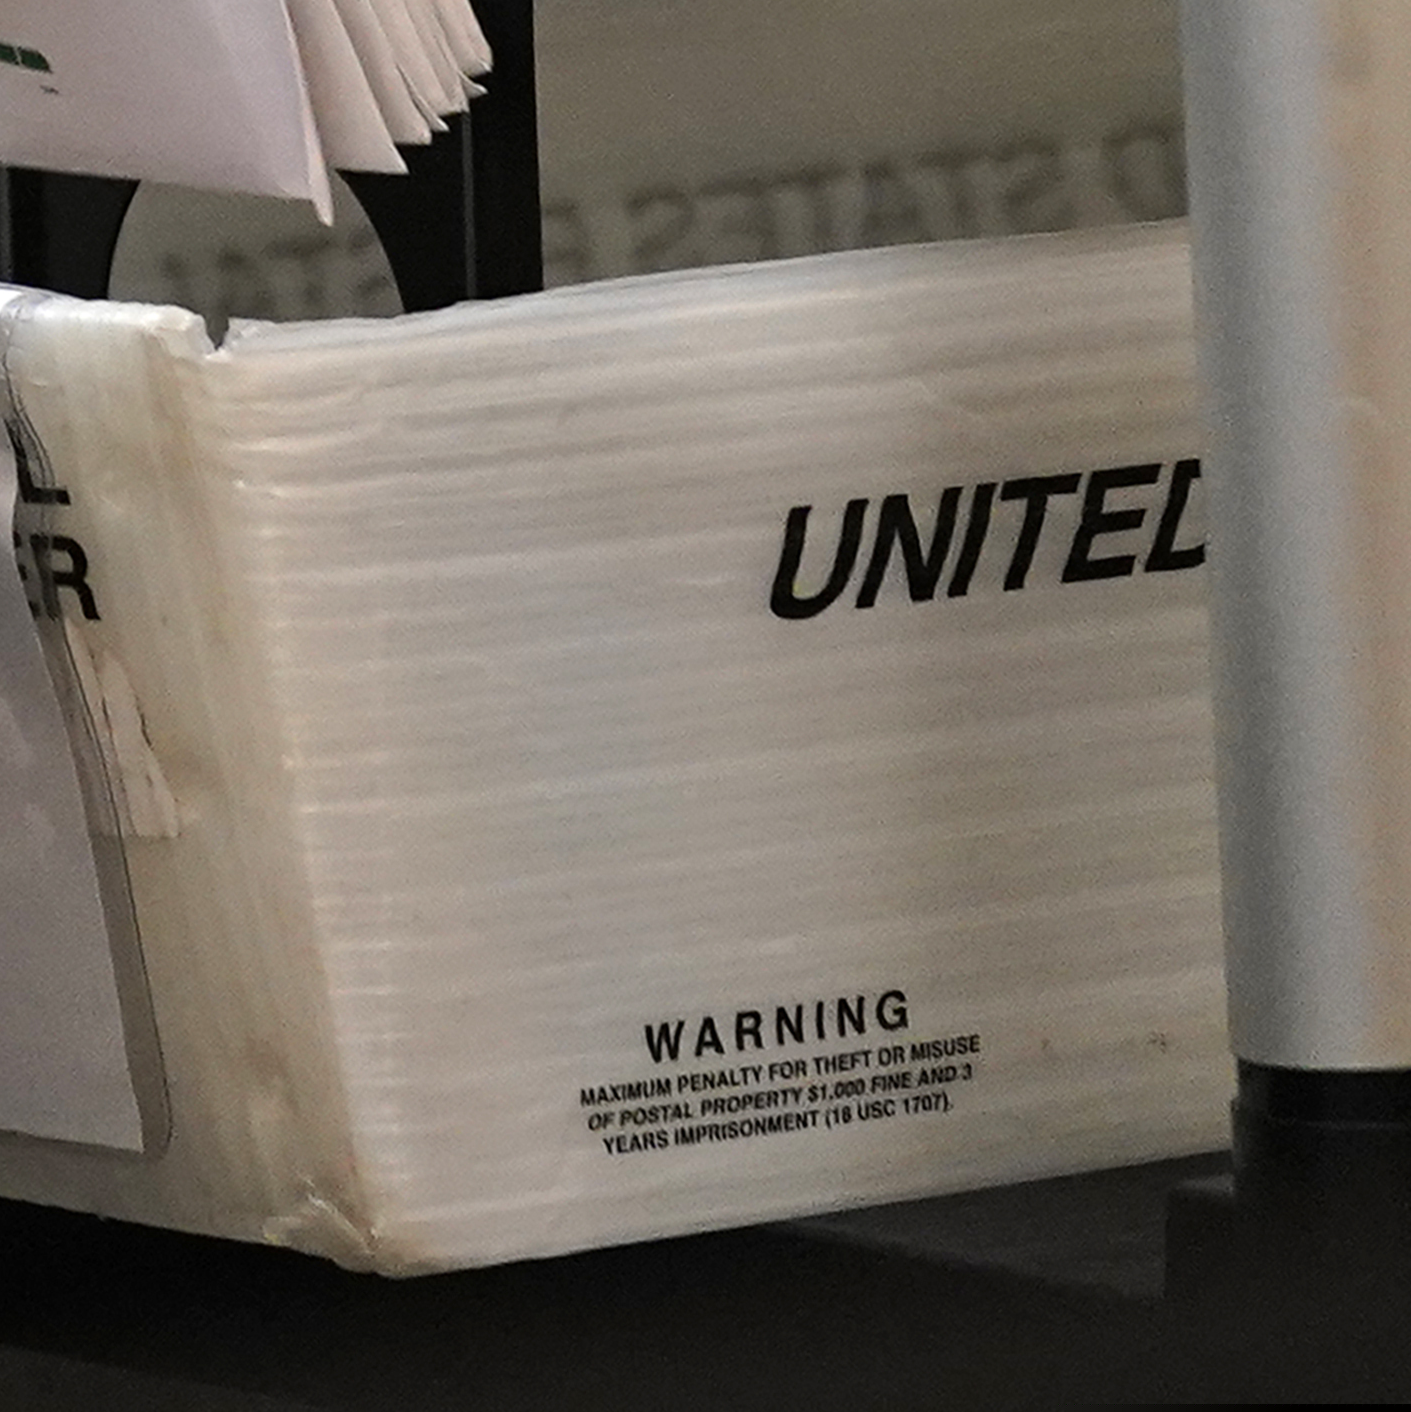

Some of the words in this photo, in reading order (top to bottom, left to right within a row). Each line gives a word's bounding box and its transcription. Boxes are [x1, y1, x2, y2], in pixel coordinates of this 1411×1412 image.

[644, 990, 910, 1064] WARNING
[580, 1077, 672, 1108] MAXIMUM
[677, 1065, 763, 1096] PENALTY
[768, 1059, 807, 1082] FOR
[812, 1049, 873, 1077] THEFT
[878, 1043, 906, 1067] OR
[910, 1034, 981, 1062] MISUSE
[587, 1111, 615, 1132] OF
[619, 1097, 694, 1129] POSTAL
[700, 1088, 803, 1117] PROPERTY
[870, 1072, 913, 1094] FINE
[917, 1065, 958, 1087] AND
[960, 1063, 974, 1082] 3
[603, 1128, 670, 1156] YEARS
[674, 1110, 819, 1147] IMPRISONMENT
[825, 1105, 853, 1130] (18
[856, 1099, 898, 1125] USC
